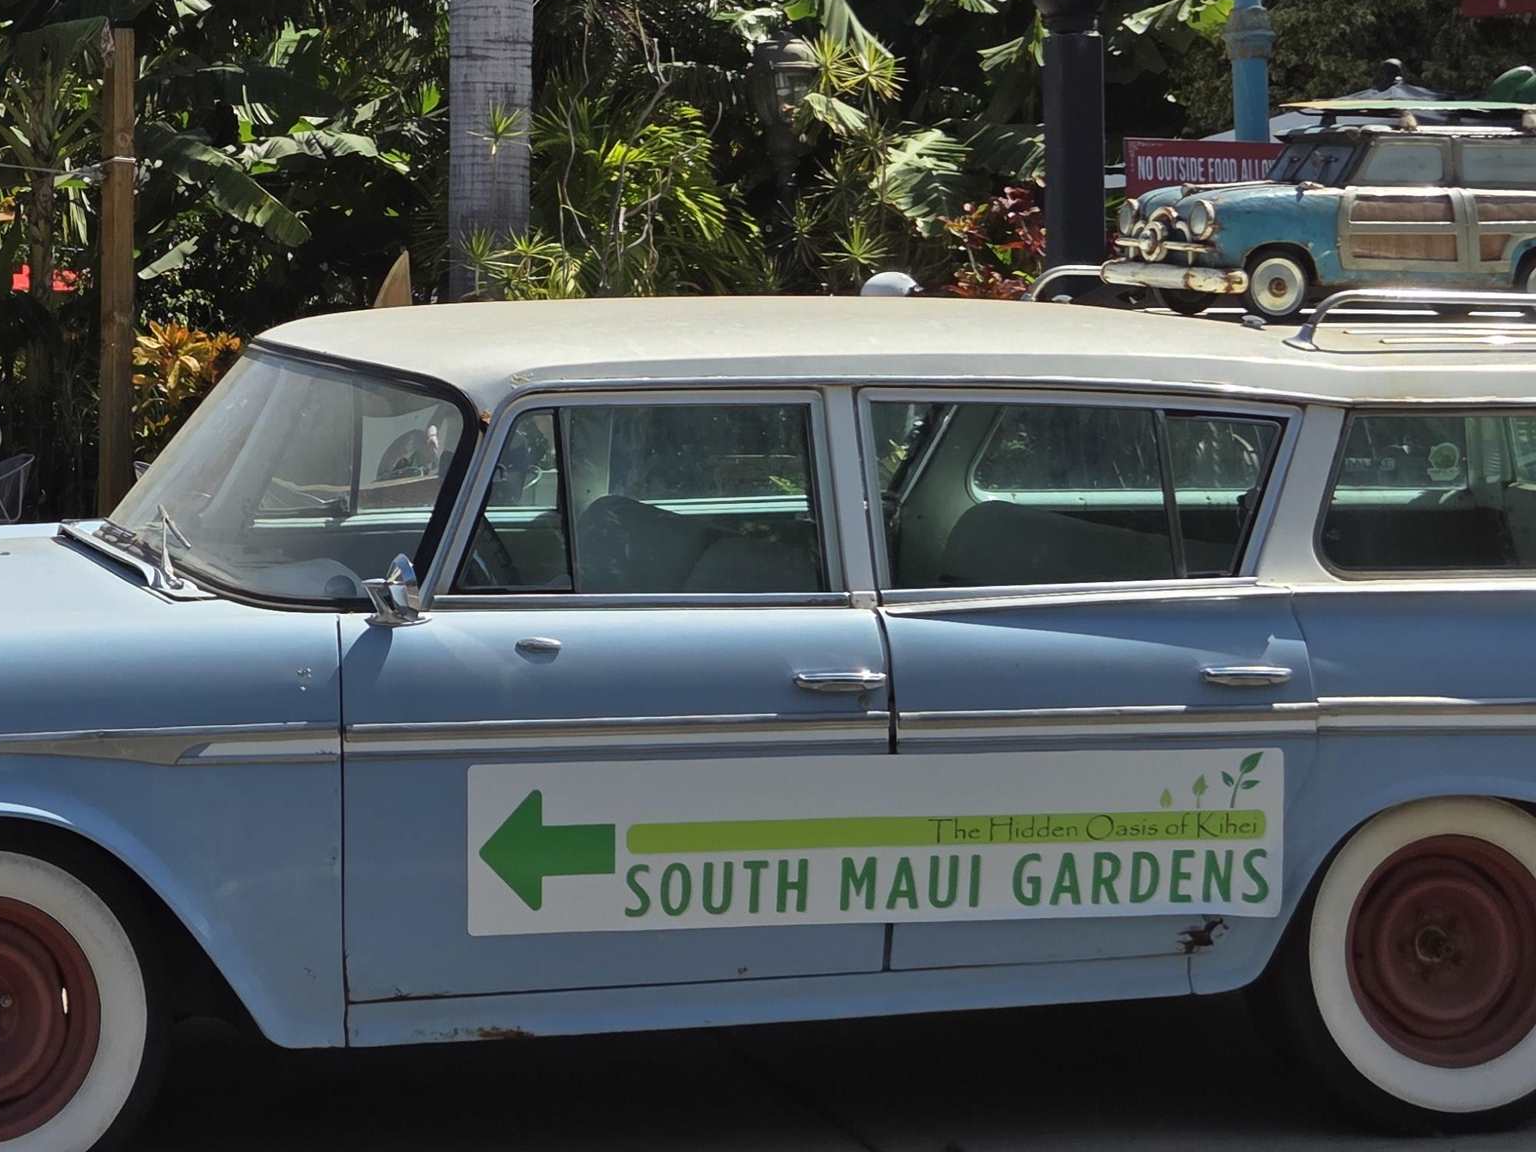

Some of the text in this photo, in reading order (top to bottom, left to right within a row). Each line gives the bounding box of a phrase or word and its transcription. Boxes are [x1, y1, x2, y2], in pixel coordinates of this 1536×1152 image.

[1137, 155, 1275, 182] NO OUTSIDE FOOD ALLO
[928, 812, 1258, 844] The Hidden Oasis of Kihei
[624, 848, 1270, 918] SOUTH MAUI GARDENS
